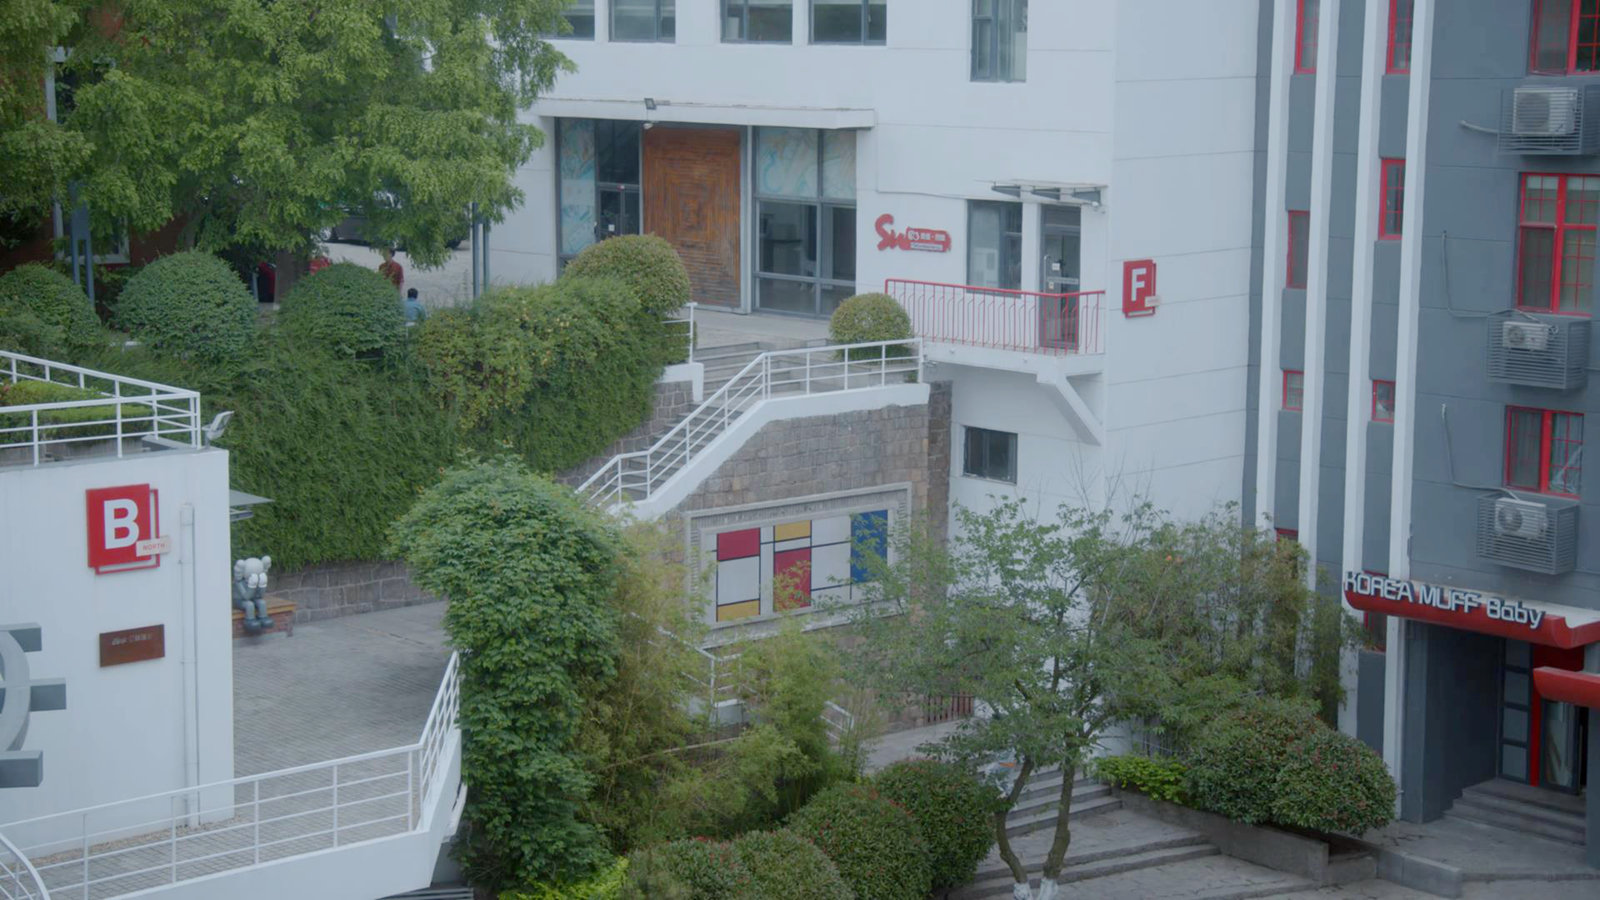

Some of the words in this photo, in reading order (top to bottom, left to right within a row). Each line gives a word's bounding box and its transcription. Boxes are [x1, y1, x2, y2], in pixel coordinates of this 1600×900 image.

[1131, 267, 1147, 302] F
[104, 498, 139, 550] B
[142, 542, 166, 551] NORTH
[1344, 571, 1413, 603] KOREA
[1419, 585, 1480, 613] MUFF
[1486, 598, 1544, 629] Baby
